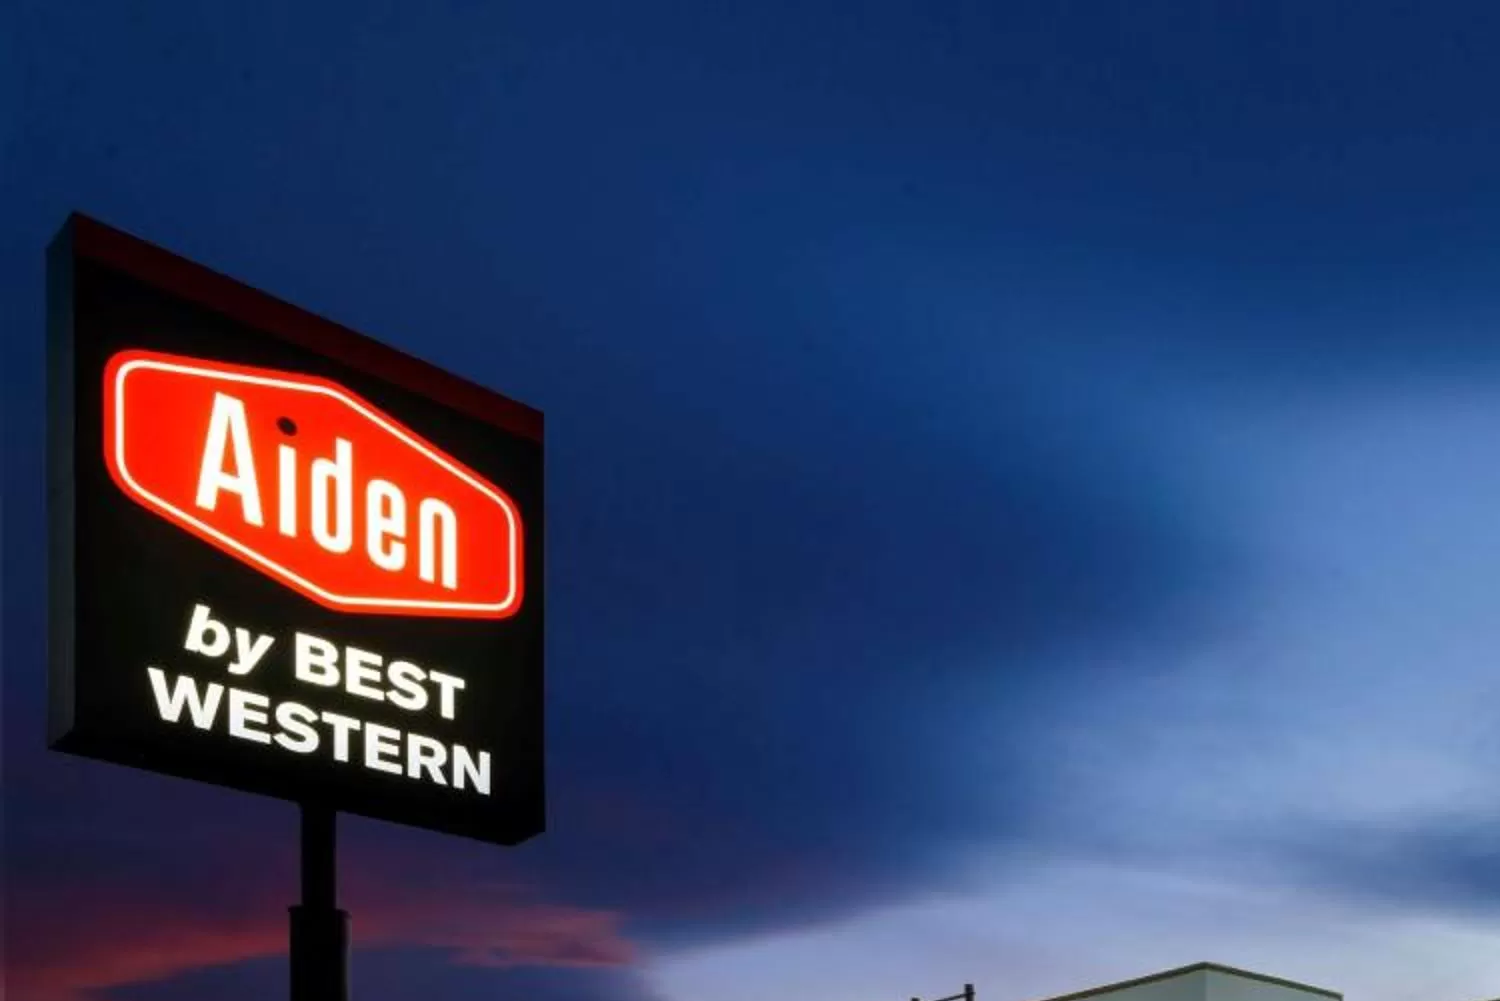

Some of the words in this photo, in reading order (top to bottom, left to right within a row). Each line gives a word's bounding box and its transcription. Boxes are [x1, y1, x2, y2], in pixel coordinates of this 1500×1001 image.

[195, 391, 458, 590] Aiden
[184, 603, 275, 675] by
[295, 631, 466, 720] BEST
[147, 667, 491, 795] WESTERN
